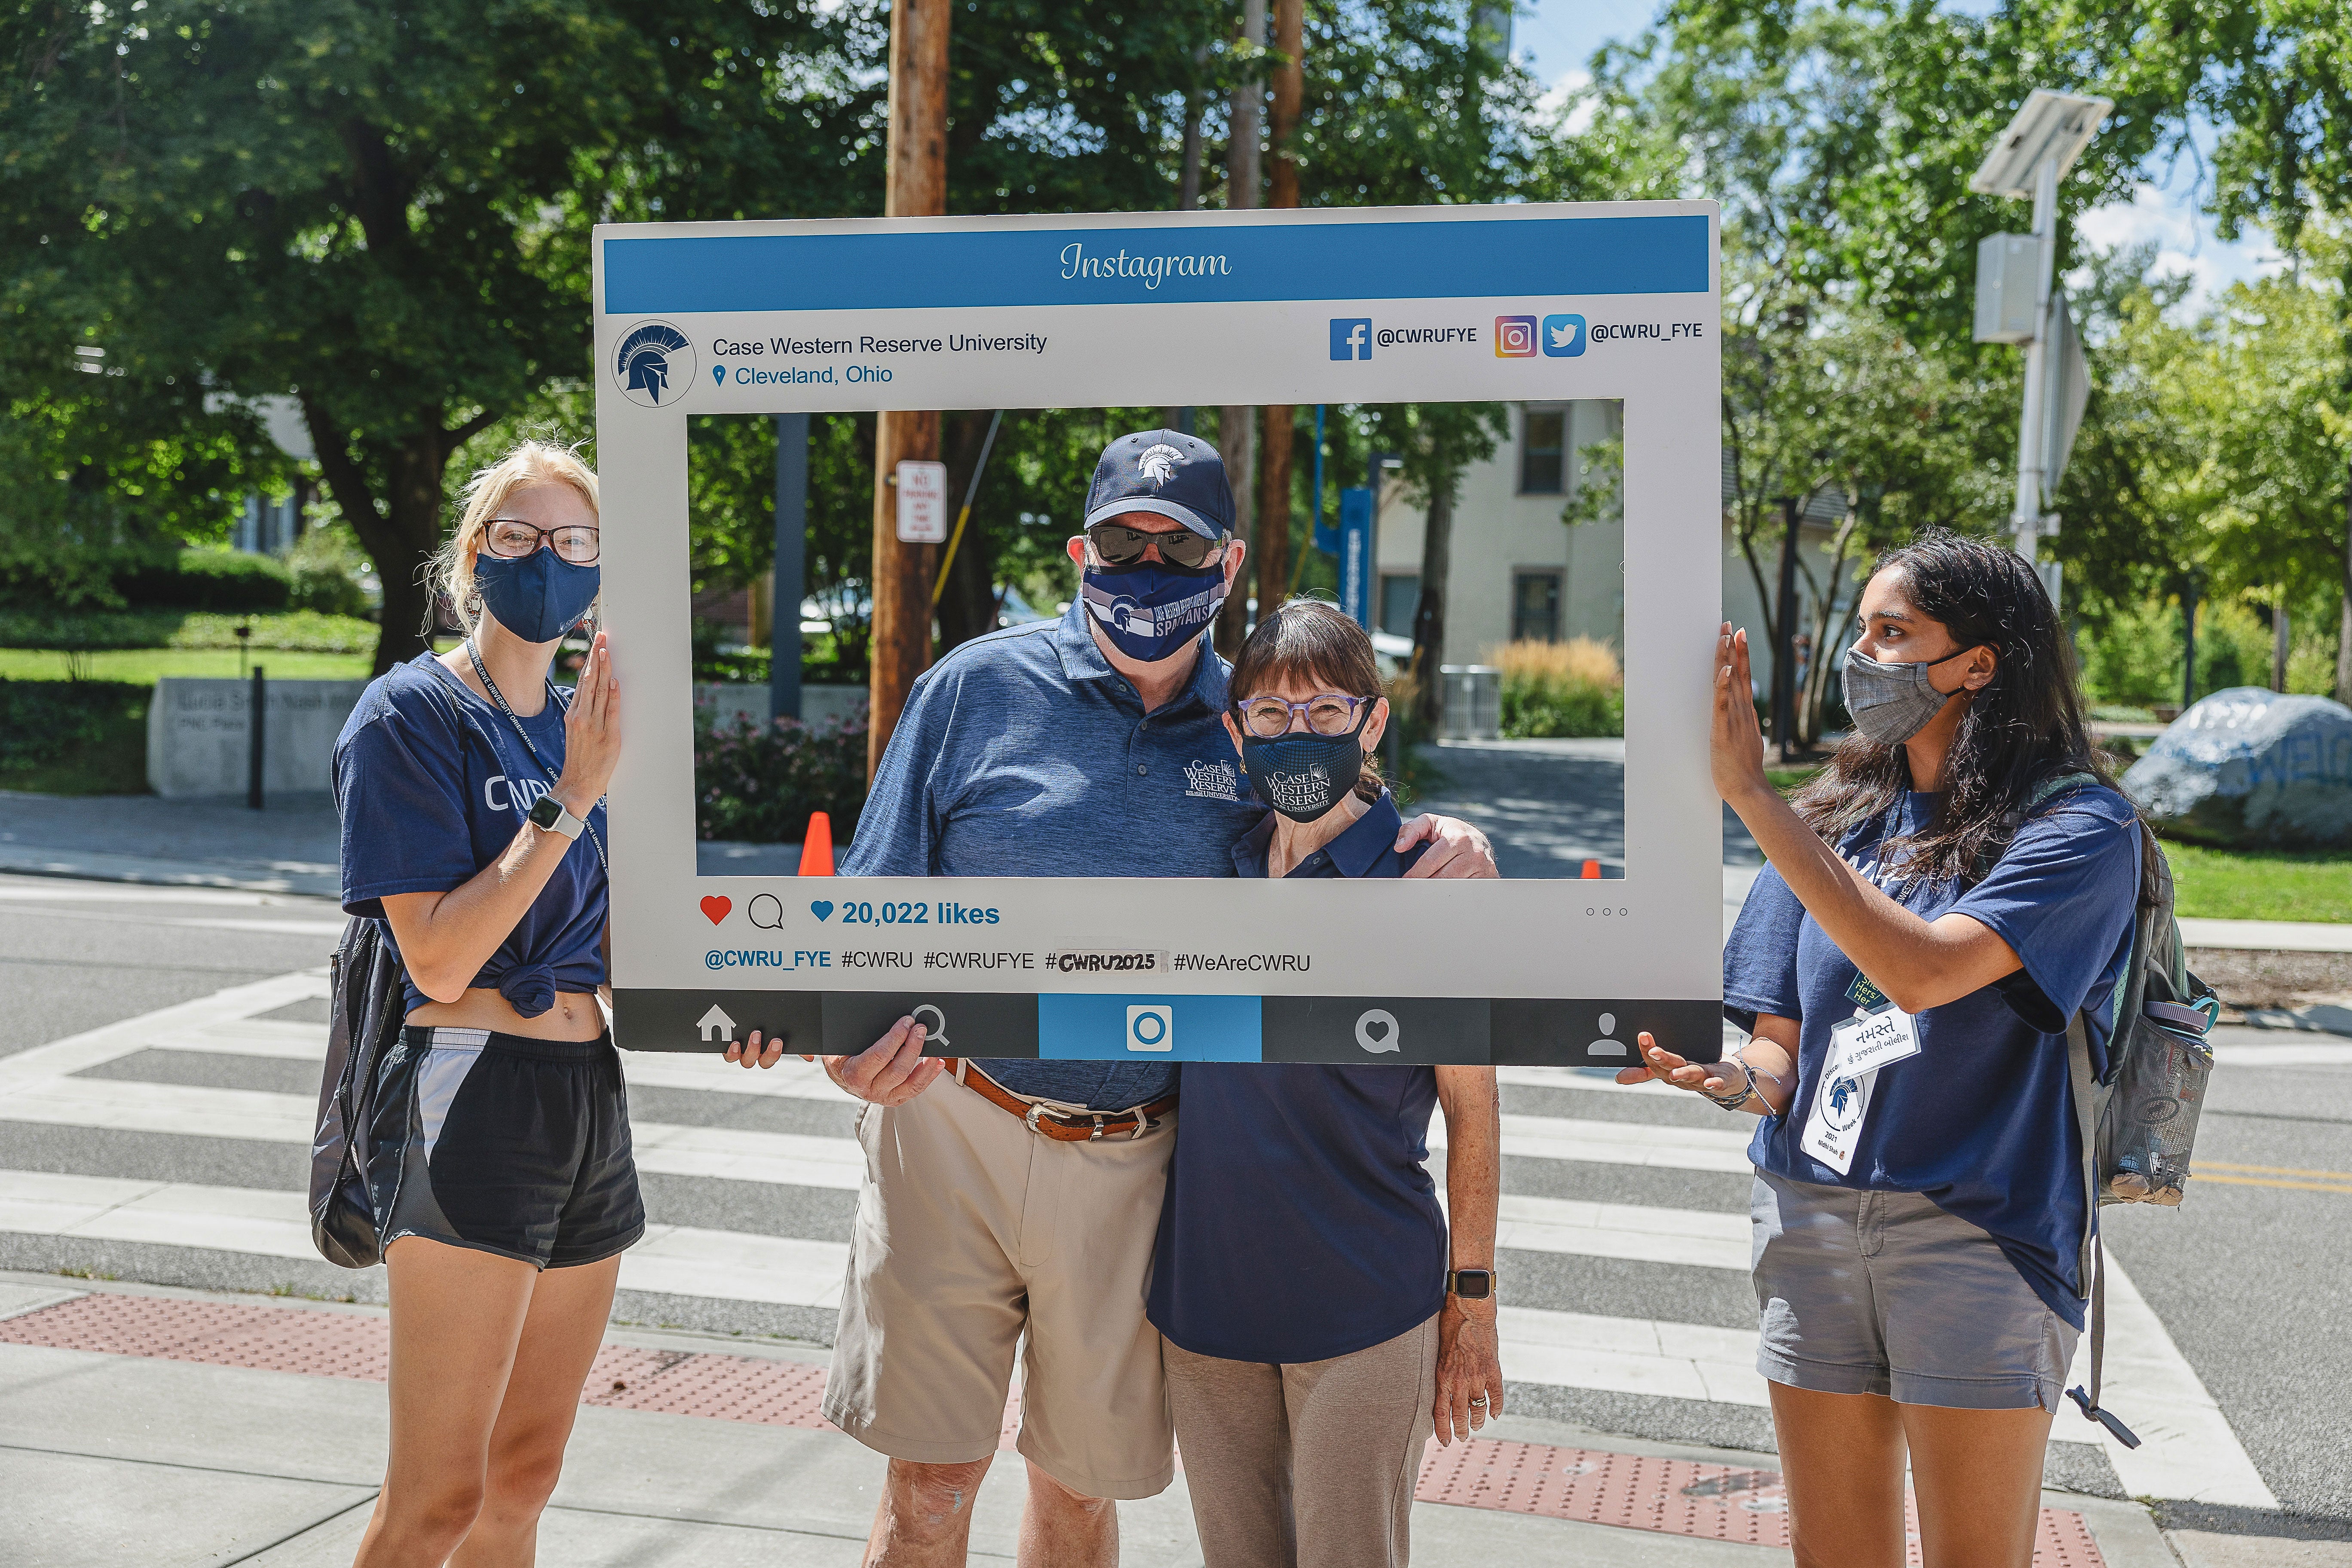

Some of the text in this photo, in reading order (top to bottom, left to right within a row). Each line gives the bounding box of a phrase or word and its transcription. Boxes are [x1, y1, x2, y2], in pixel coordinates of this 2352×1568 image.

[1060, 243, 1232, 290] Instagram
[1377, 328, 1477, 347] @CWRUFYE
[1590, 323, 1703, 343] @CWRU_FYE
[713, 334, 1047, 356] Case Western Reserve University
[735, 365, 892, 386] Cleveland, Ohio
[473, 656, 491, 684] RESERVE
[488, 683, 513, 716] UNIVERSITY
[510, 715, 537, 753] ORIENTATION
[547, 767, 559, 782] CASE
[1192, 760, 1222, 774] CASE
[1183, 768, 1237, 787] WESTERN
[1189, 778, 1237, 795] RESERVE
[1265, 775, 1330, 795] WESTERN
[1273, 772, 1310, 784] CASE
[1203, 790, 1240, 802] UNIVERSITY
[1271, 788, 1329, 806] RESERVE
[1287, 798, 1329, 812] UNIVERSITY
[583, 818, 607, 867] ERVE UNIVERSITY
[1899, 870, 1923, 902] WESTERN
[842, 902, 1000, 928] 20,022 likes
[705, 949, 831, 971] @CWRU_FYE
[841, 951, 913, 968] #CWRU
[924, 951, 1035, 969] #CWRUFYE
[1174, 953, 1311, 971] #WeAreCWRU
[1853, 991, 1871, 1005] Her
[1855, 981, 1881, 1000] Hers/
[1825, 1064, 1839, 1080] Disco
[1842, 1118, 1856, 1132] Week
[1825, 1131, 1837, 1143] 2021
[1829, 1145, 1838, 1155] Shah
